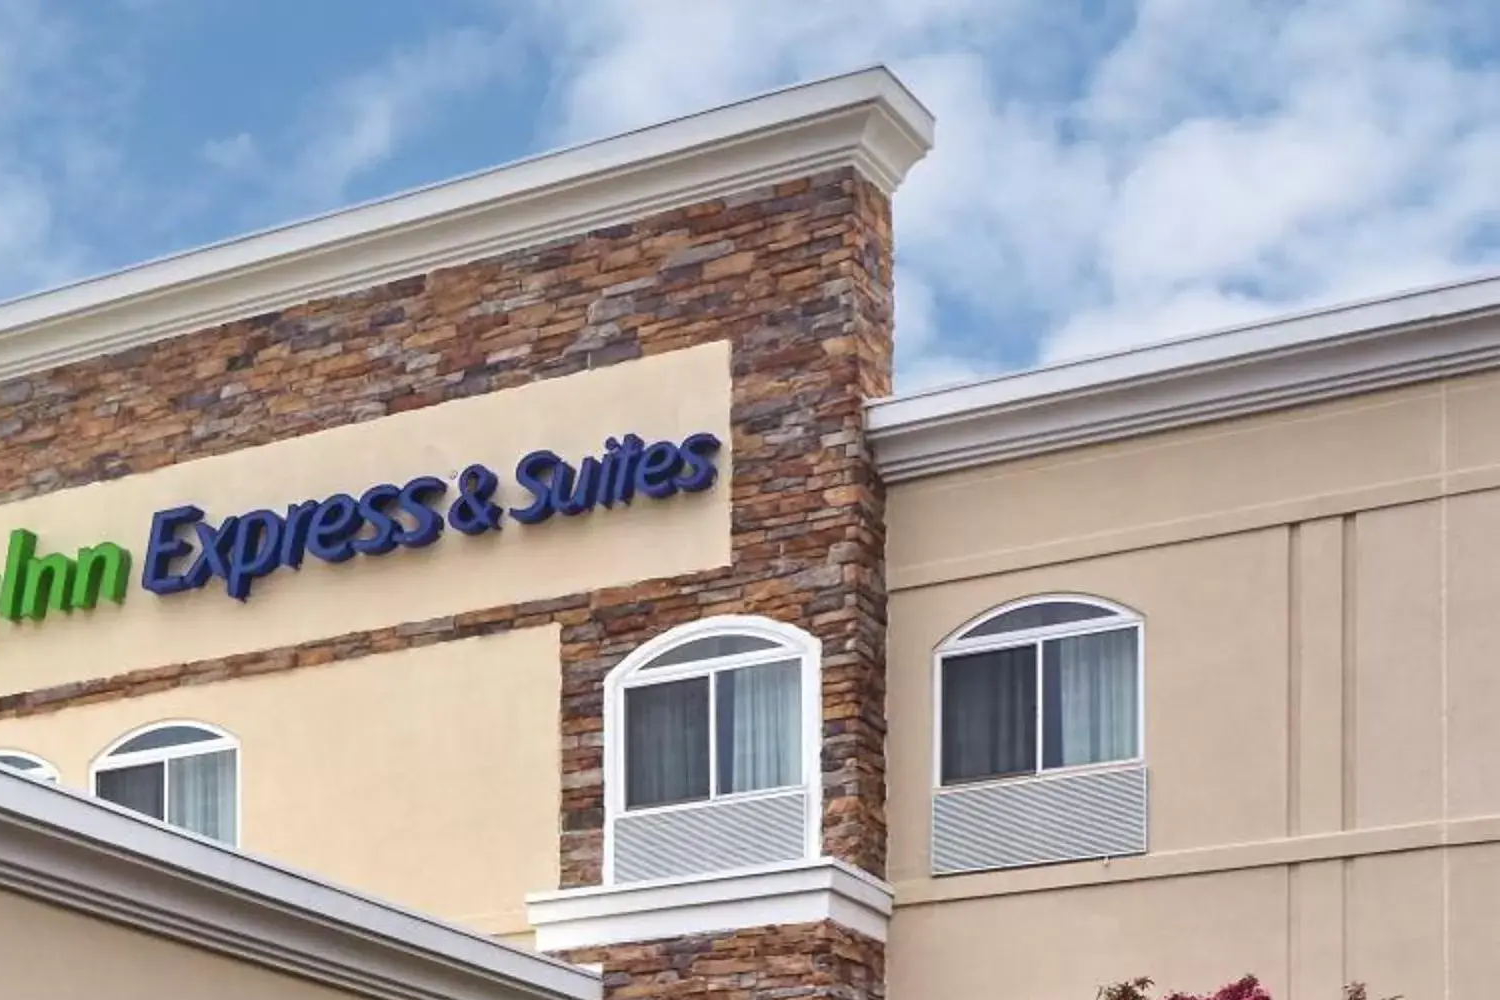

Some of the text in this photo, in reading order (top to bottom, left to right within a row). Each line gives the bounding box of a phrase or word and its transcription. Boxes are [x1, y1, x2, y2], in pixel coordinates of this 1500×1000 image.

[2, 529, 131, 621] Inn
[143, 477, 446, 600] Express
[448, 463, 503, 535] &
[510, 433, 721, 524] Suites
